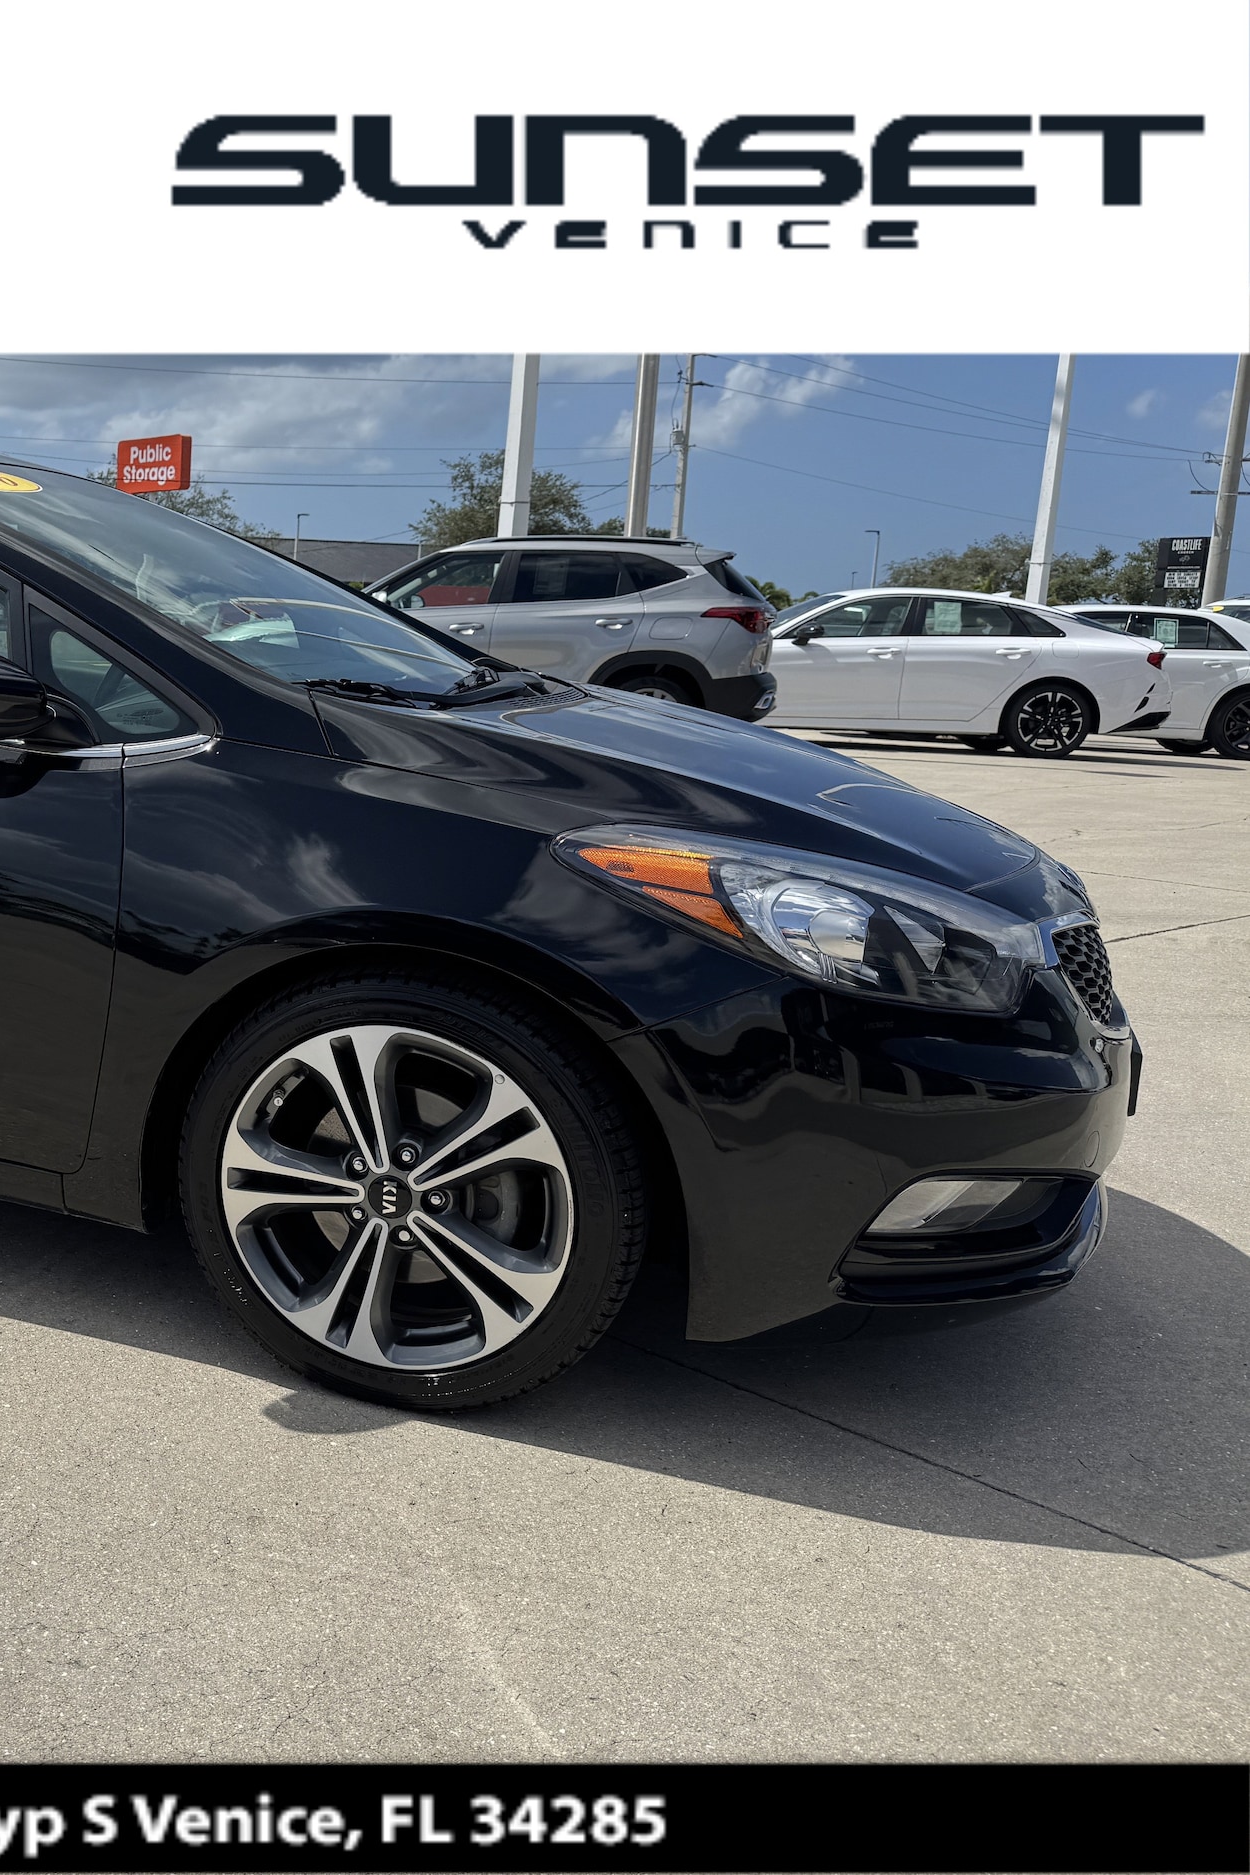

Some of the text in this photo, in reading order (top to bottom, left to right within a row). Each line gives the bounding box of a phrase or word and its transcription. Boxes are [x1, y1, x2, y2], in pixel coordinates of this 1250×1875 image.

[130, 443, 172, 464] Public
[123, 465, 176, 486] Storage
[1171, 539, 1202, 551] COASTLIFE
[382, 1180, 398, 1214] KIA
